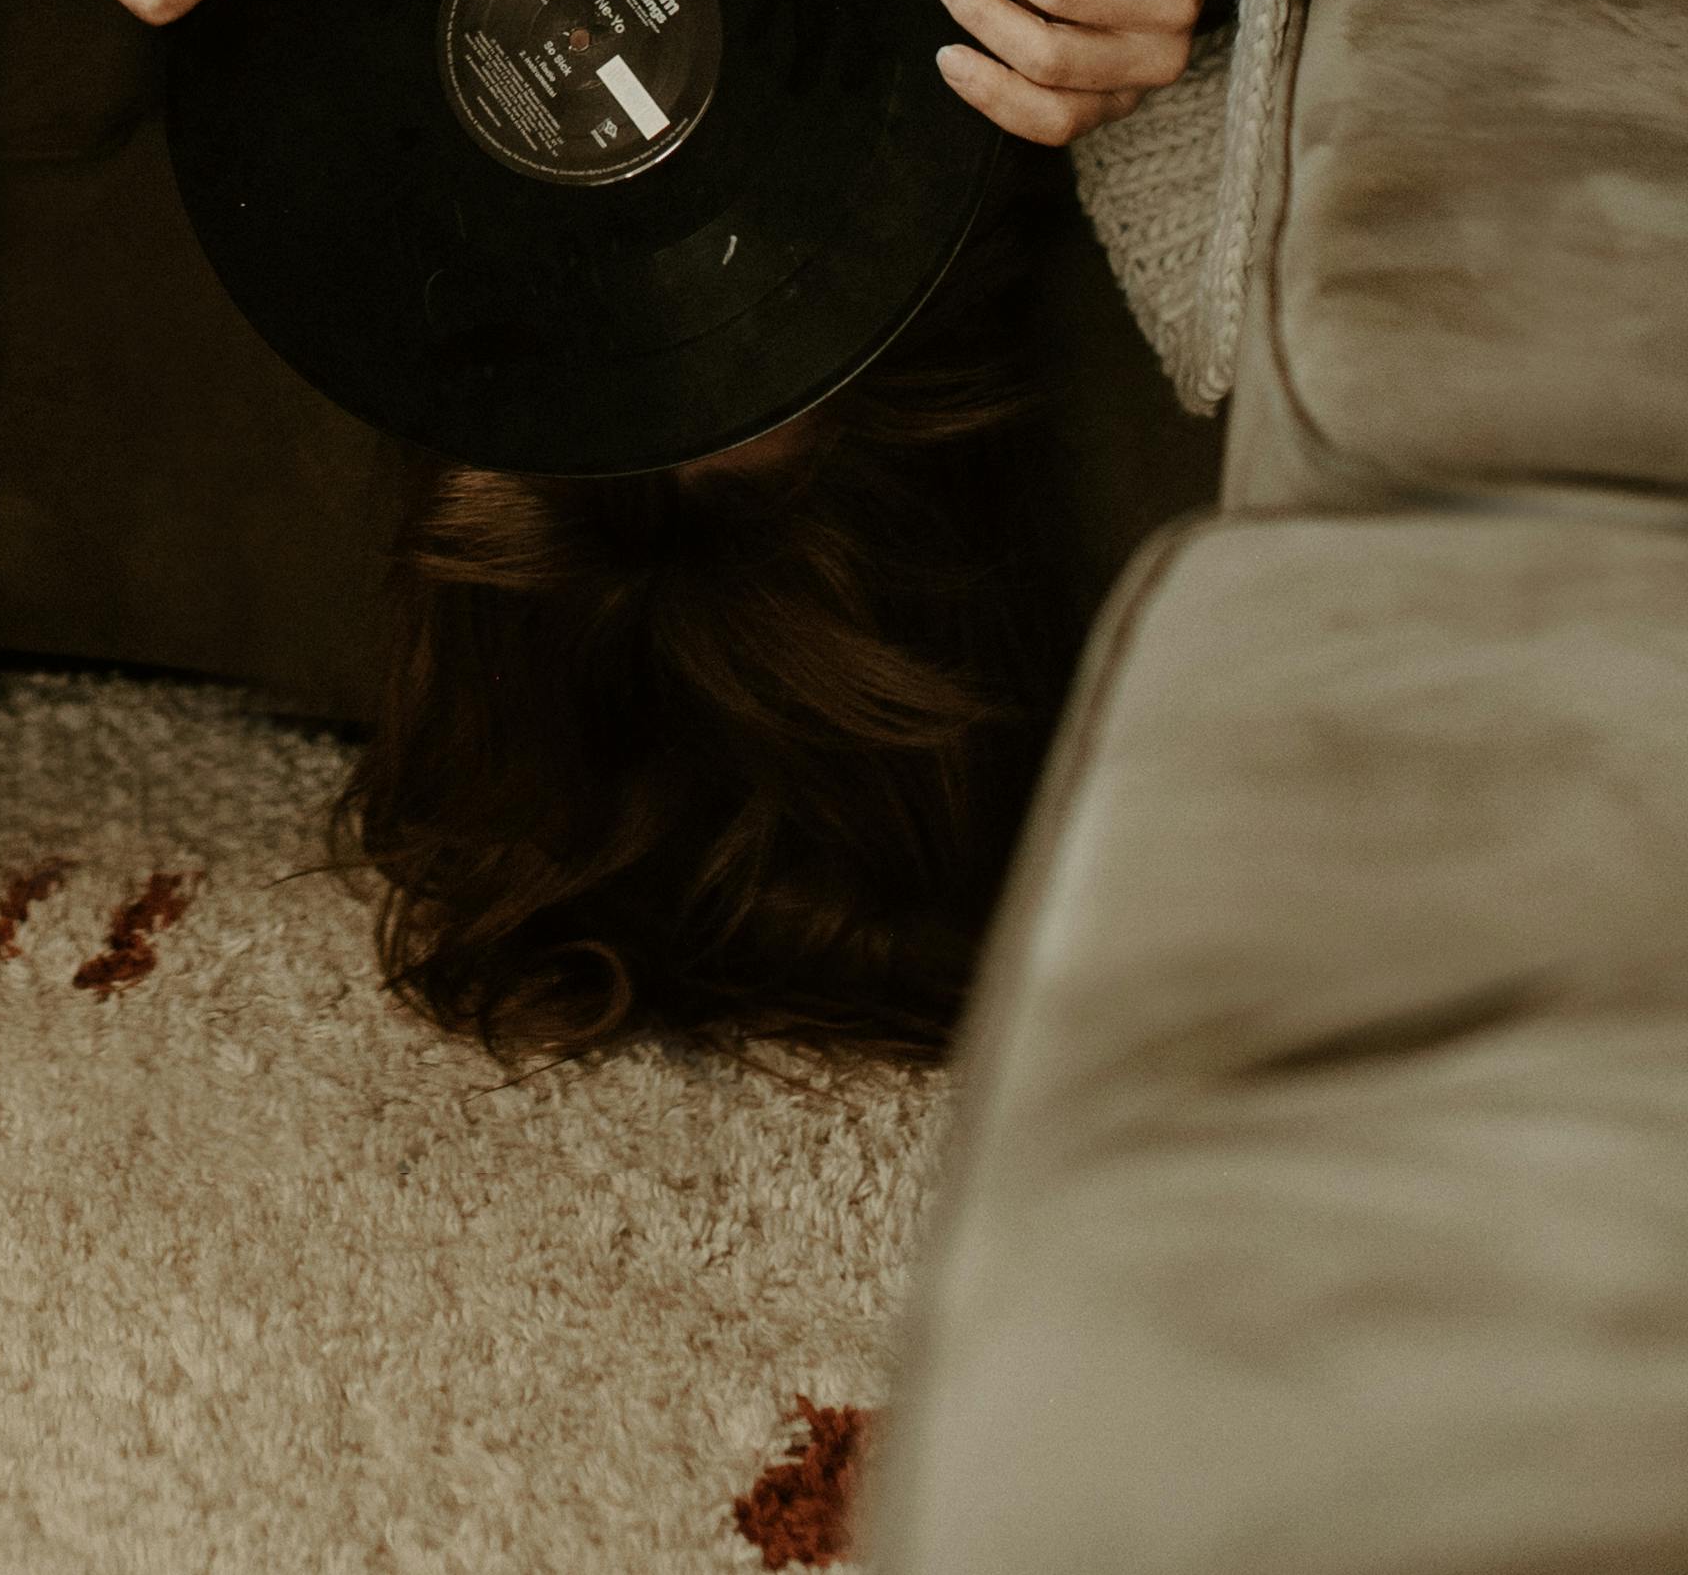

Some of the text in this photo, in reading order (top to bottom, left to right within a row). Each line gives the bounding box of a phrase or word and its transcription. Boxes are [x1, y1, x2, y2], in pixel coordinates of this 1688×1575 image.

[539, 61, 556, 82] Radio
[543, 40, 572, 76] So Sick
[524, 57, 557, 97] Instrumental
